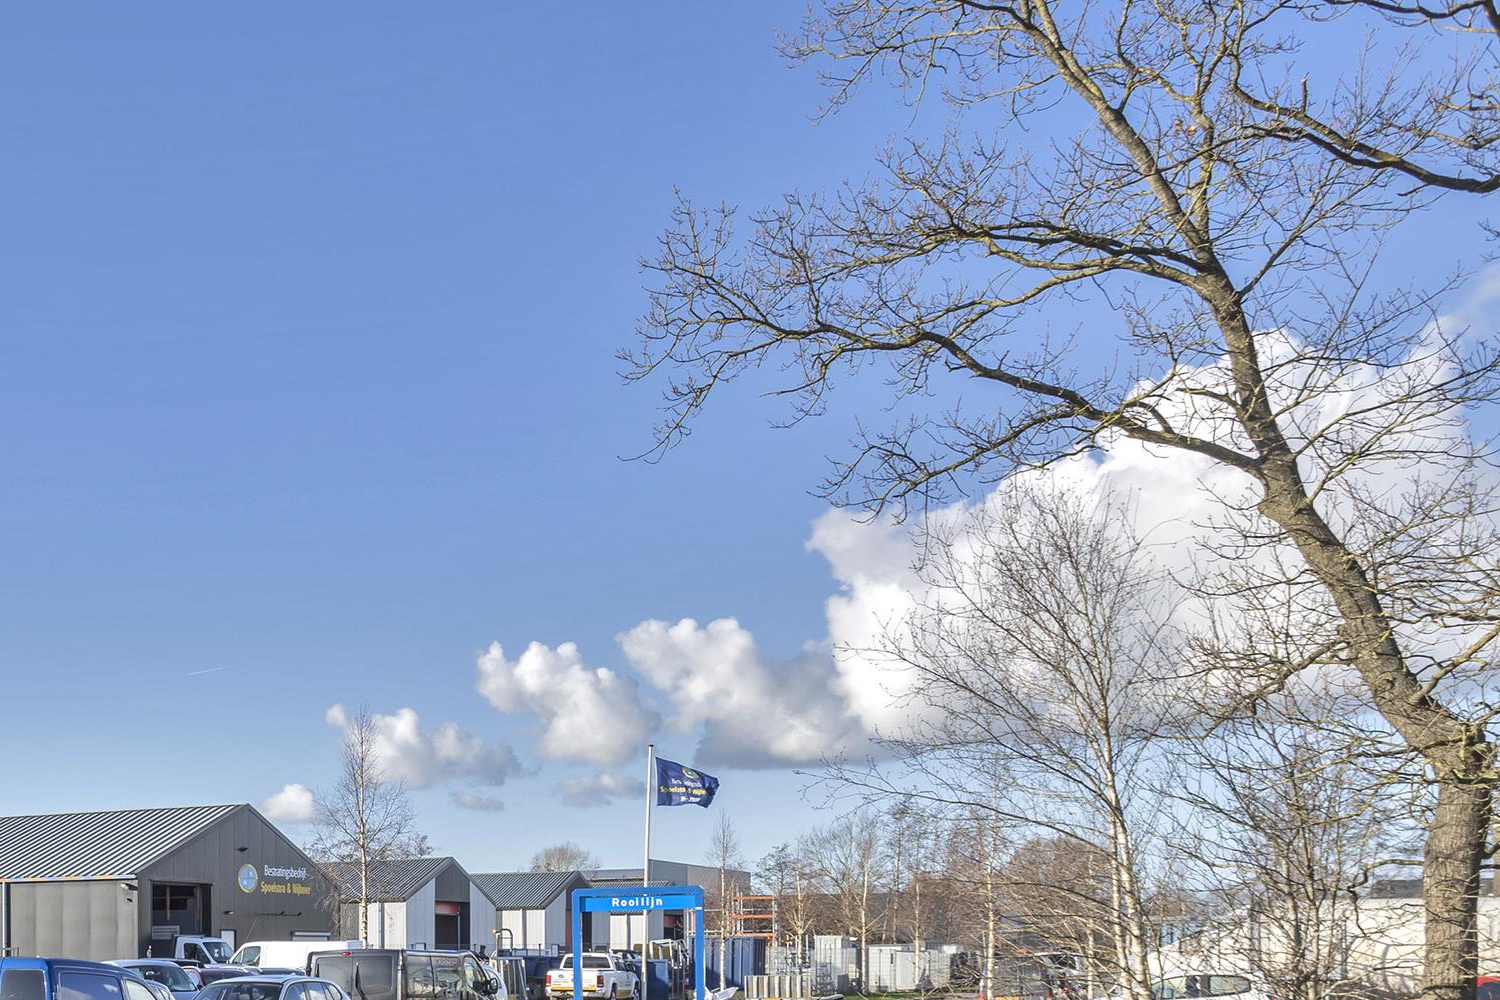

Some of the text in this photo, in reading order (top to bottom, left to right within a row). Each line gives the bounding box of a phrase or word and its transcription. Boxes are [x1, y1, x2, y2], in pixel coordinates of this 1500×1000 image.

[264, 864, 307, 881] Bestratingsbedrijf
[261, 881, 285, 895] Spoelstra
[286, 883, 292, 894] &
[612, 897, 663, 908] Rooilijn
